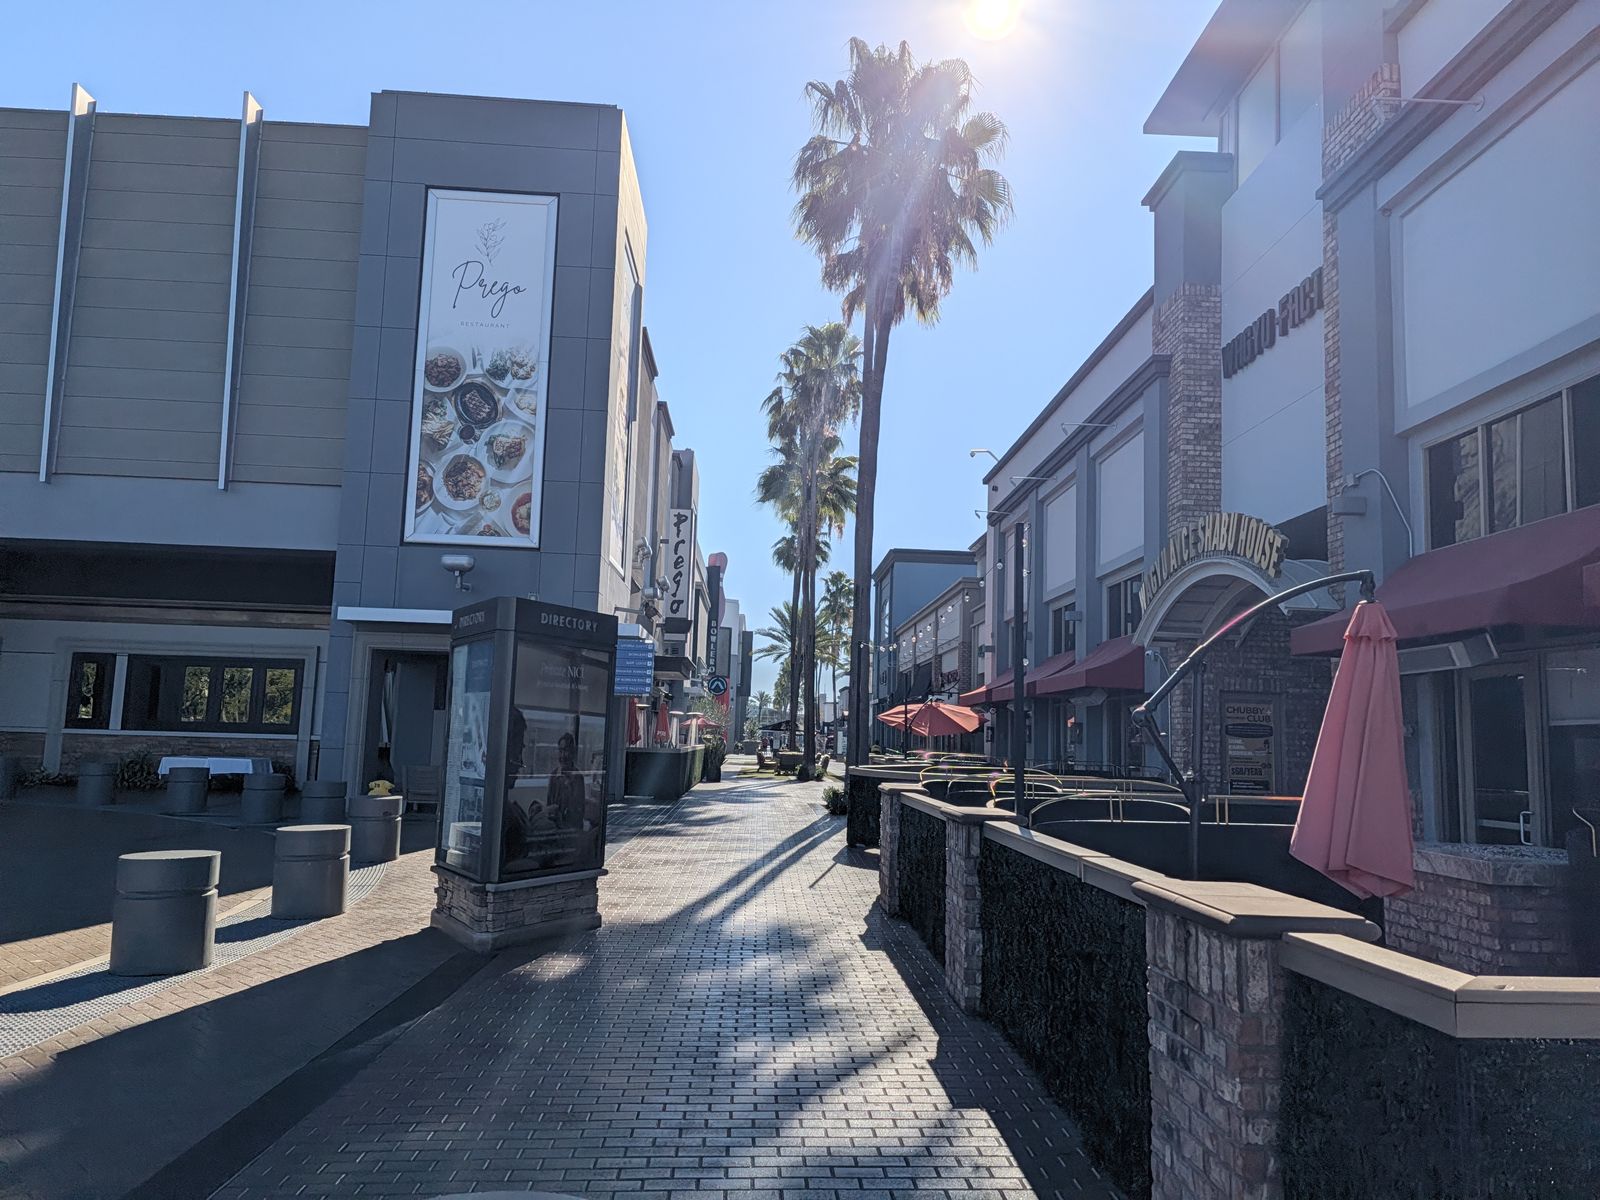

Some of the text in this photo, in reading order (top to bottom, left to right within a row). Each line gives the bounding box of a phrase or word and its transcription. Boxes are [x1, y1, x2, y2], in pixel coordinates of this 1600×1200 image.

[452, 260, 526, 318] Prego
[459, 320, 511, 329] RESTAURANT
[1138, 512, 1285, 611] WAGYU AYCE SHABU HOUSE
[540, 612, 599, 633] DIRECTORY
[708, 620, 717, 673] BOWLERO
[1226, 706, 1265, 715] CHUBBY
[1246, 714, 1272, 723] CLUB
